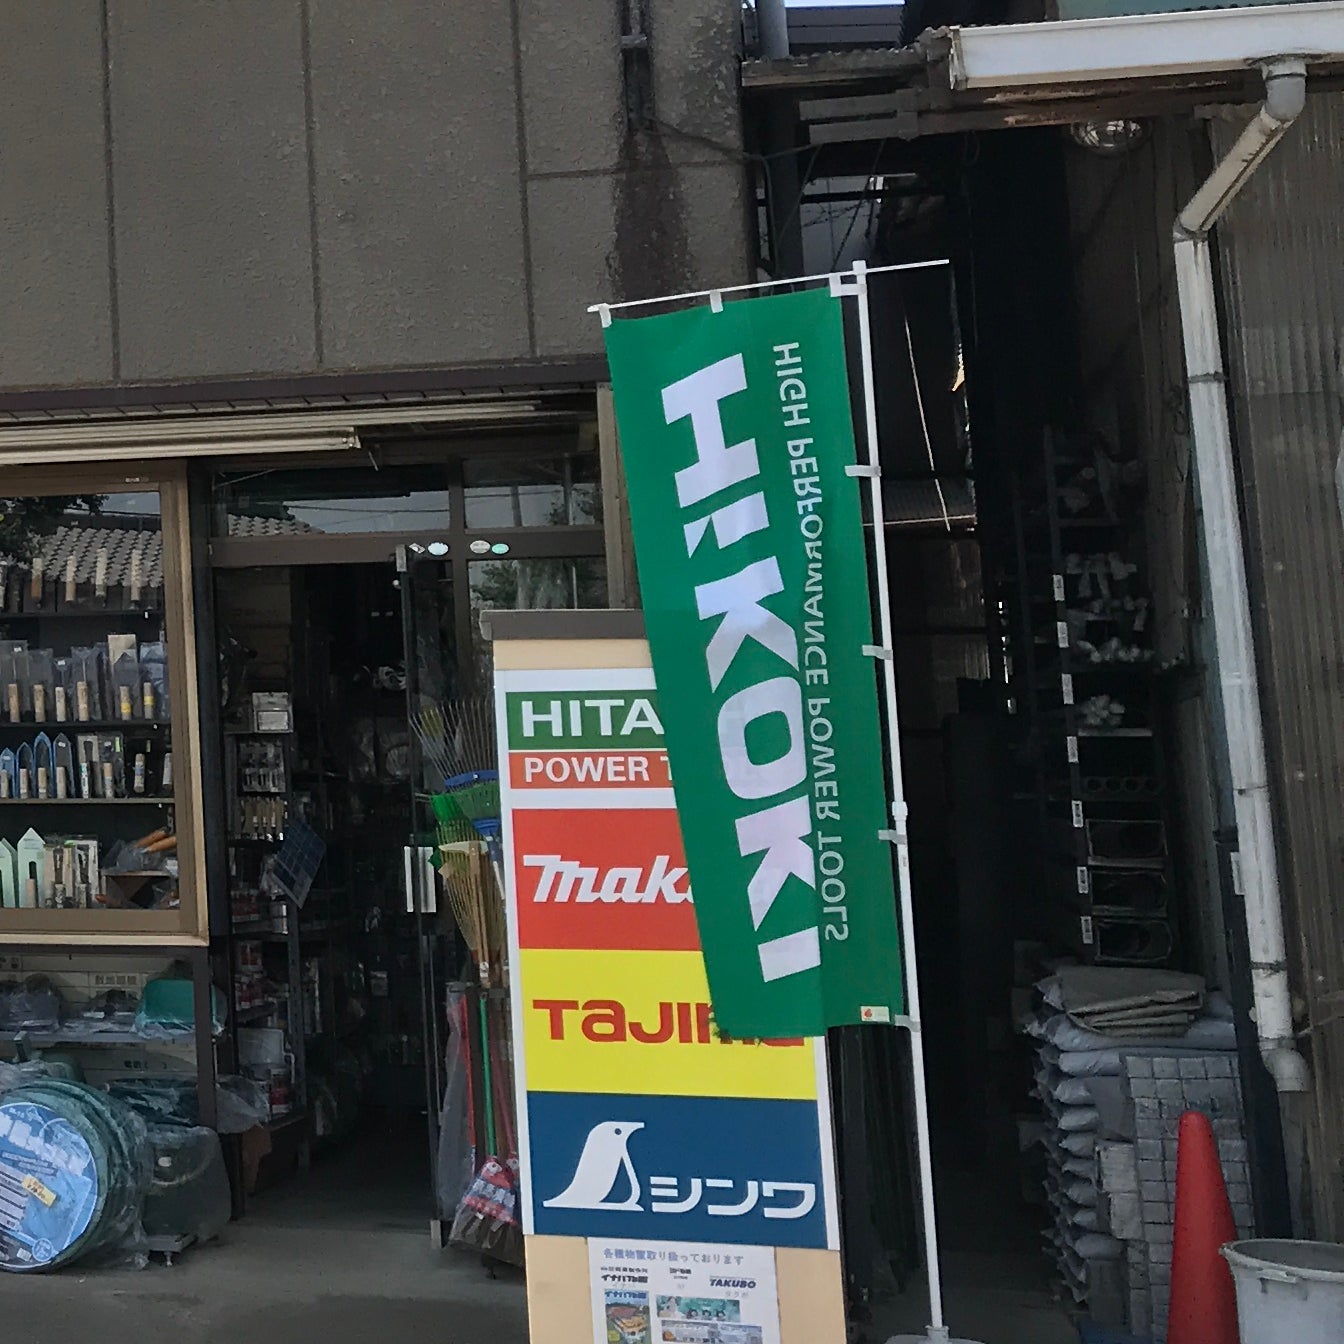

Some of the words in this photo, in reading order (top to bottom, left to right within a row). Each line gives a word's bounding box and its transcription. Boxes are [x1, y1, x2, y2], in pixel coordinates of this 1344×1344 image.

[524, 755, 651, 783] POWER
[649, 1176, 816, 1219] シンワ
[709, 1278, 757, 1289] TAKUBO
